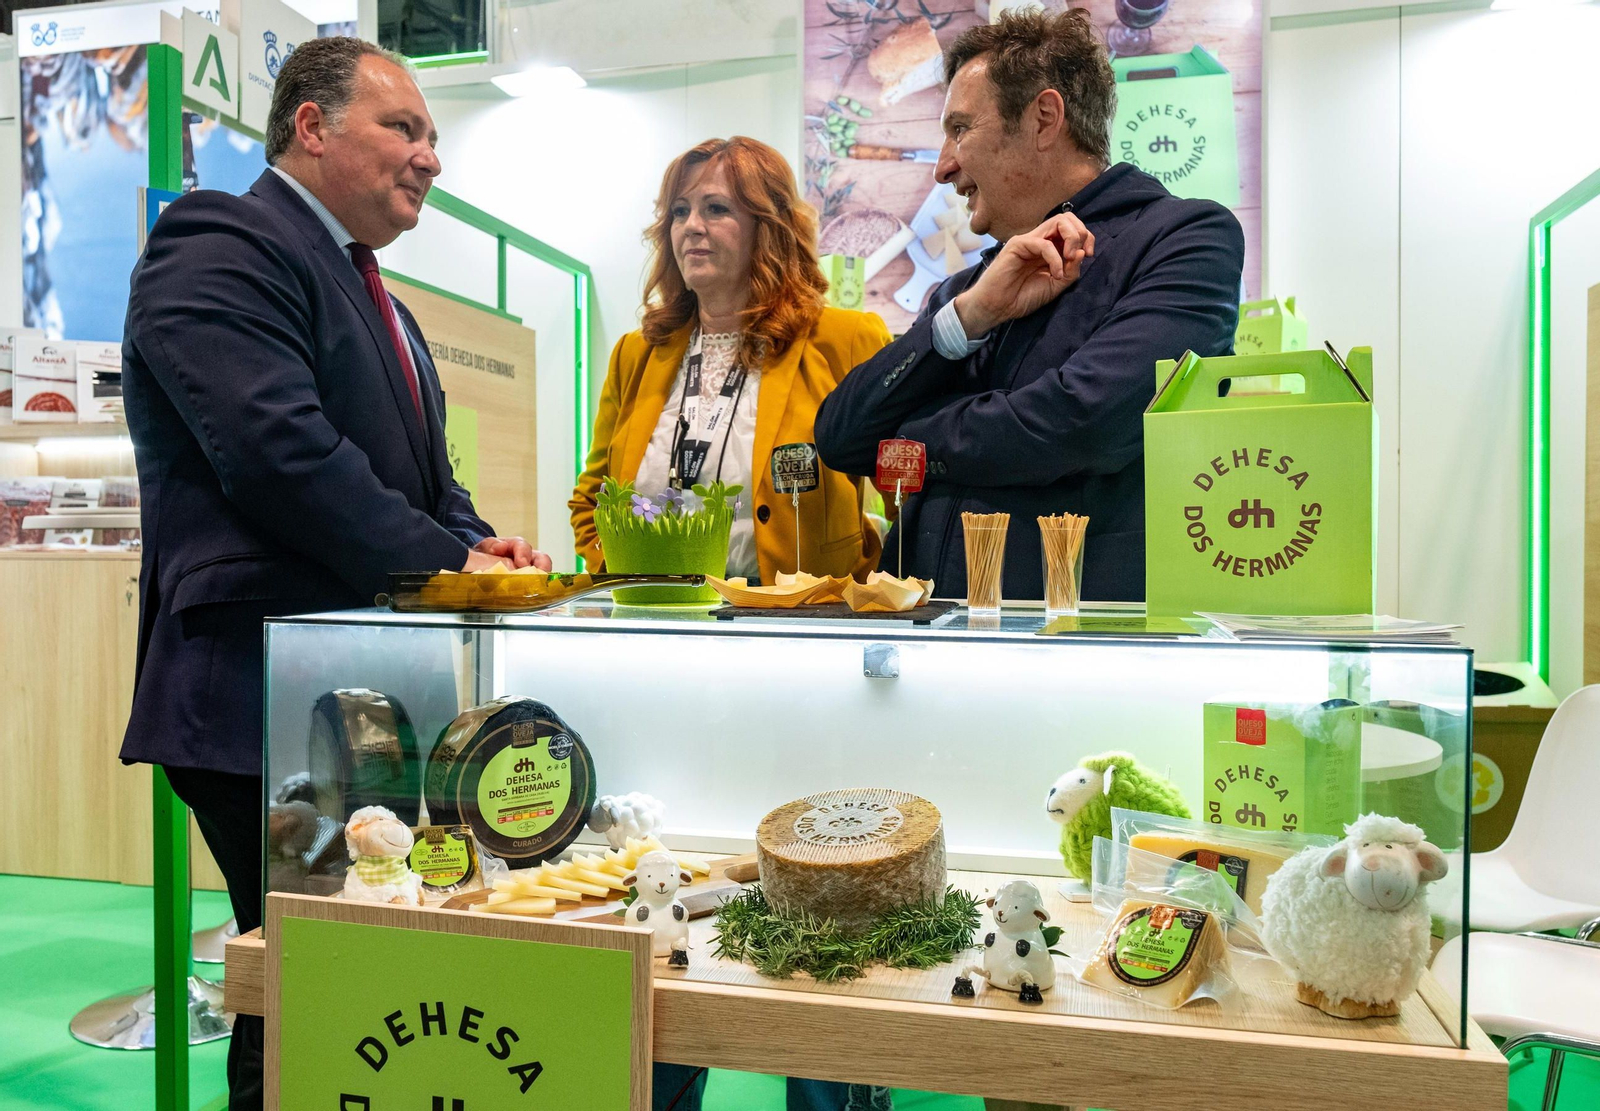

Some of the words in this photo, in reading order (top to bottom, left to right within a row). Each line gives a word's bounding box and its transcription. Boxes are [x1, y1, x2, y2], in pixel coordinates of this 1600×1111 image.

[1126, 104, 1197, 132] DEHESA
[1143, 135, 1206, 184] ERMANAS
[1234, 334, 1263, 349] HESA
[427, 340, 449, 362] ESERÍA
[450, 347, 473, 367] DEHESA
[474, 353, 486, 371] DOS
[486, 357, 515, 379] HERMANAS
[774, 446, 813, 462] QUESO
[883, 444, 921, 457] QUESO
[774, 460, 814, 474] OVEJA
[881, 457, 920, 470] OVEJA
[1193, 447, 1309, 492] DEHESA
[1184, 506, 1214, 553] DOS
[1212, 502, 1322, 578] HERMANAS
[513, 722, 534, 731] QUESO
[1238, 718, 1264, 728] QUESO
[513, 729, 534, 738] OVEJA
[1238, 728, 1263, 737] OVEJA
[506, 773, 543, 786] DEHESA
[1215, 765, 1289, 803] DEHESA
[489, 789, 507, 799] DOS
[511, 780, 560, 795] HERMANAS
[818, 802, 888, 814] DEHESA
[1209, 800, 1222, 824] DO
[513, 837, 542, 847] CURADO
[1141, 944, 1175, 955] HERMANAS
[355, 1001, 543, 1095] DEHESA
